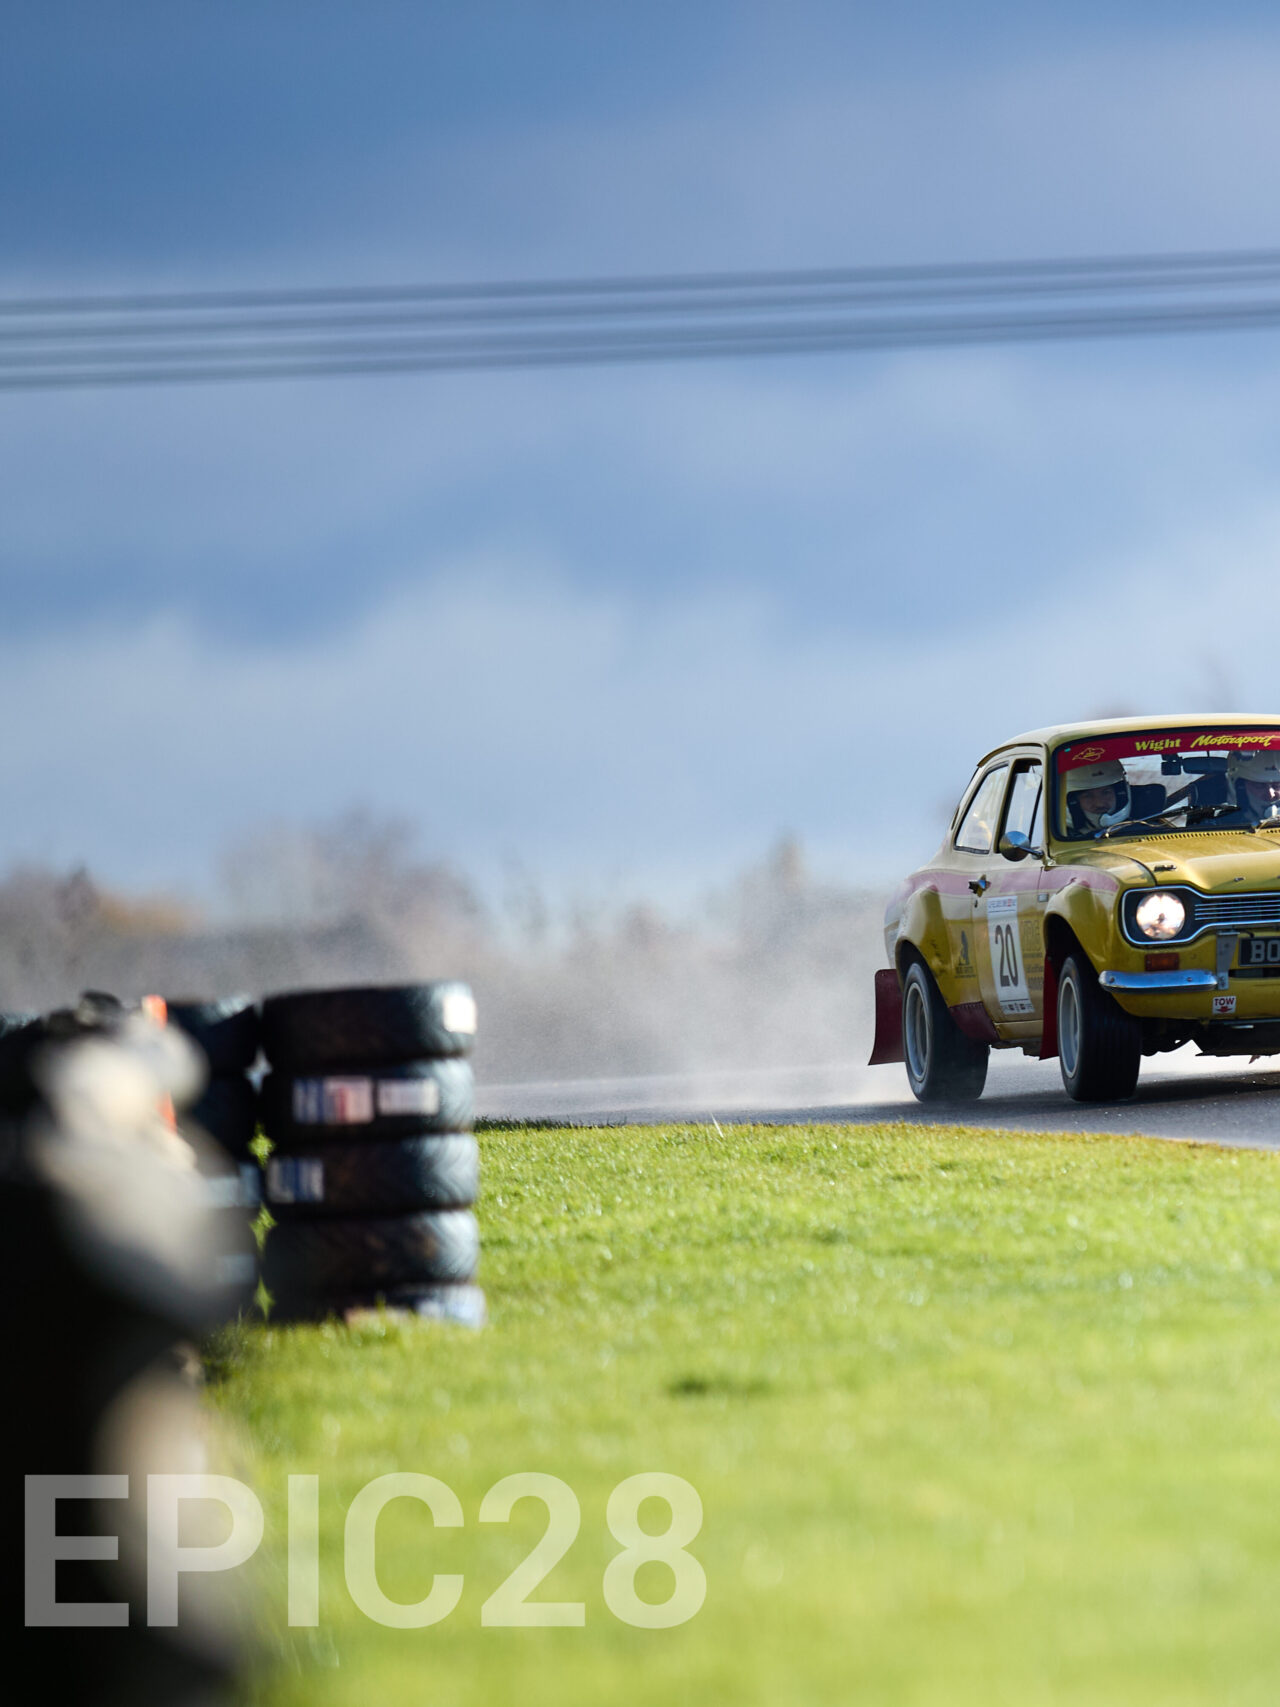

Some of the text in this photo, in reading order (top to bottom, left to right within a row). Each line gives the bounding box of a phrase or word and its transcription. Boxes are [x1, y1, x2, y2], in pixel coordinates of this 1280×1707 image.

[1135, 738, 1181, 751] Wight
[995, 924, 1019, 987] 20
[1213, 997, 1236, 1006] TOW
